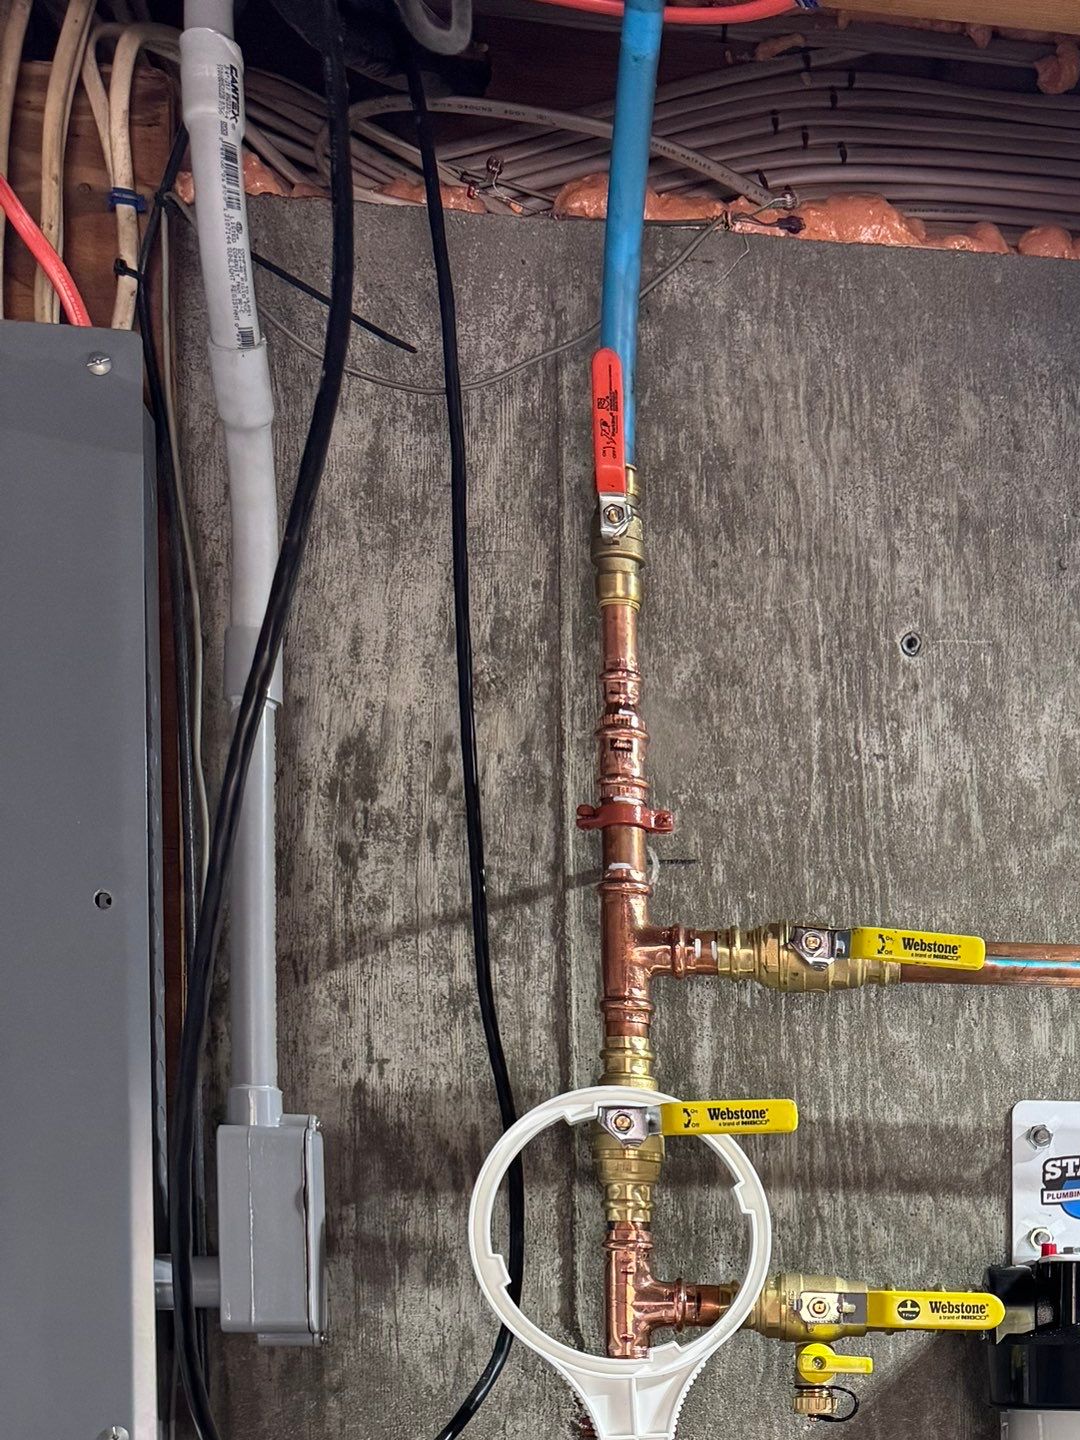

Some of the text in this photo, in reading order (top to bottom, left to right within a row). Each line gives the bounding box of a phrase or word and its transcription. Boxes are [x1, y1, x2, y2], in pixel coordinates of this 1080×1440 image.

[230, 64, 239, 124] CANTEX
[902, 936, 958, 954] Webstone
[707, 1107, 766, 1120] Webstone
[928, 1301, 986, 1314] Webstone
